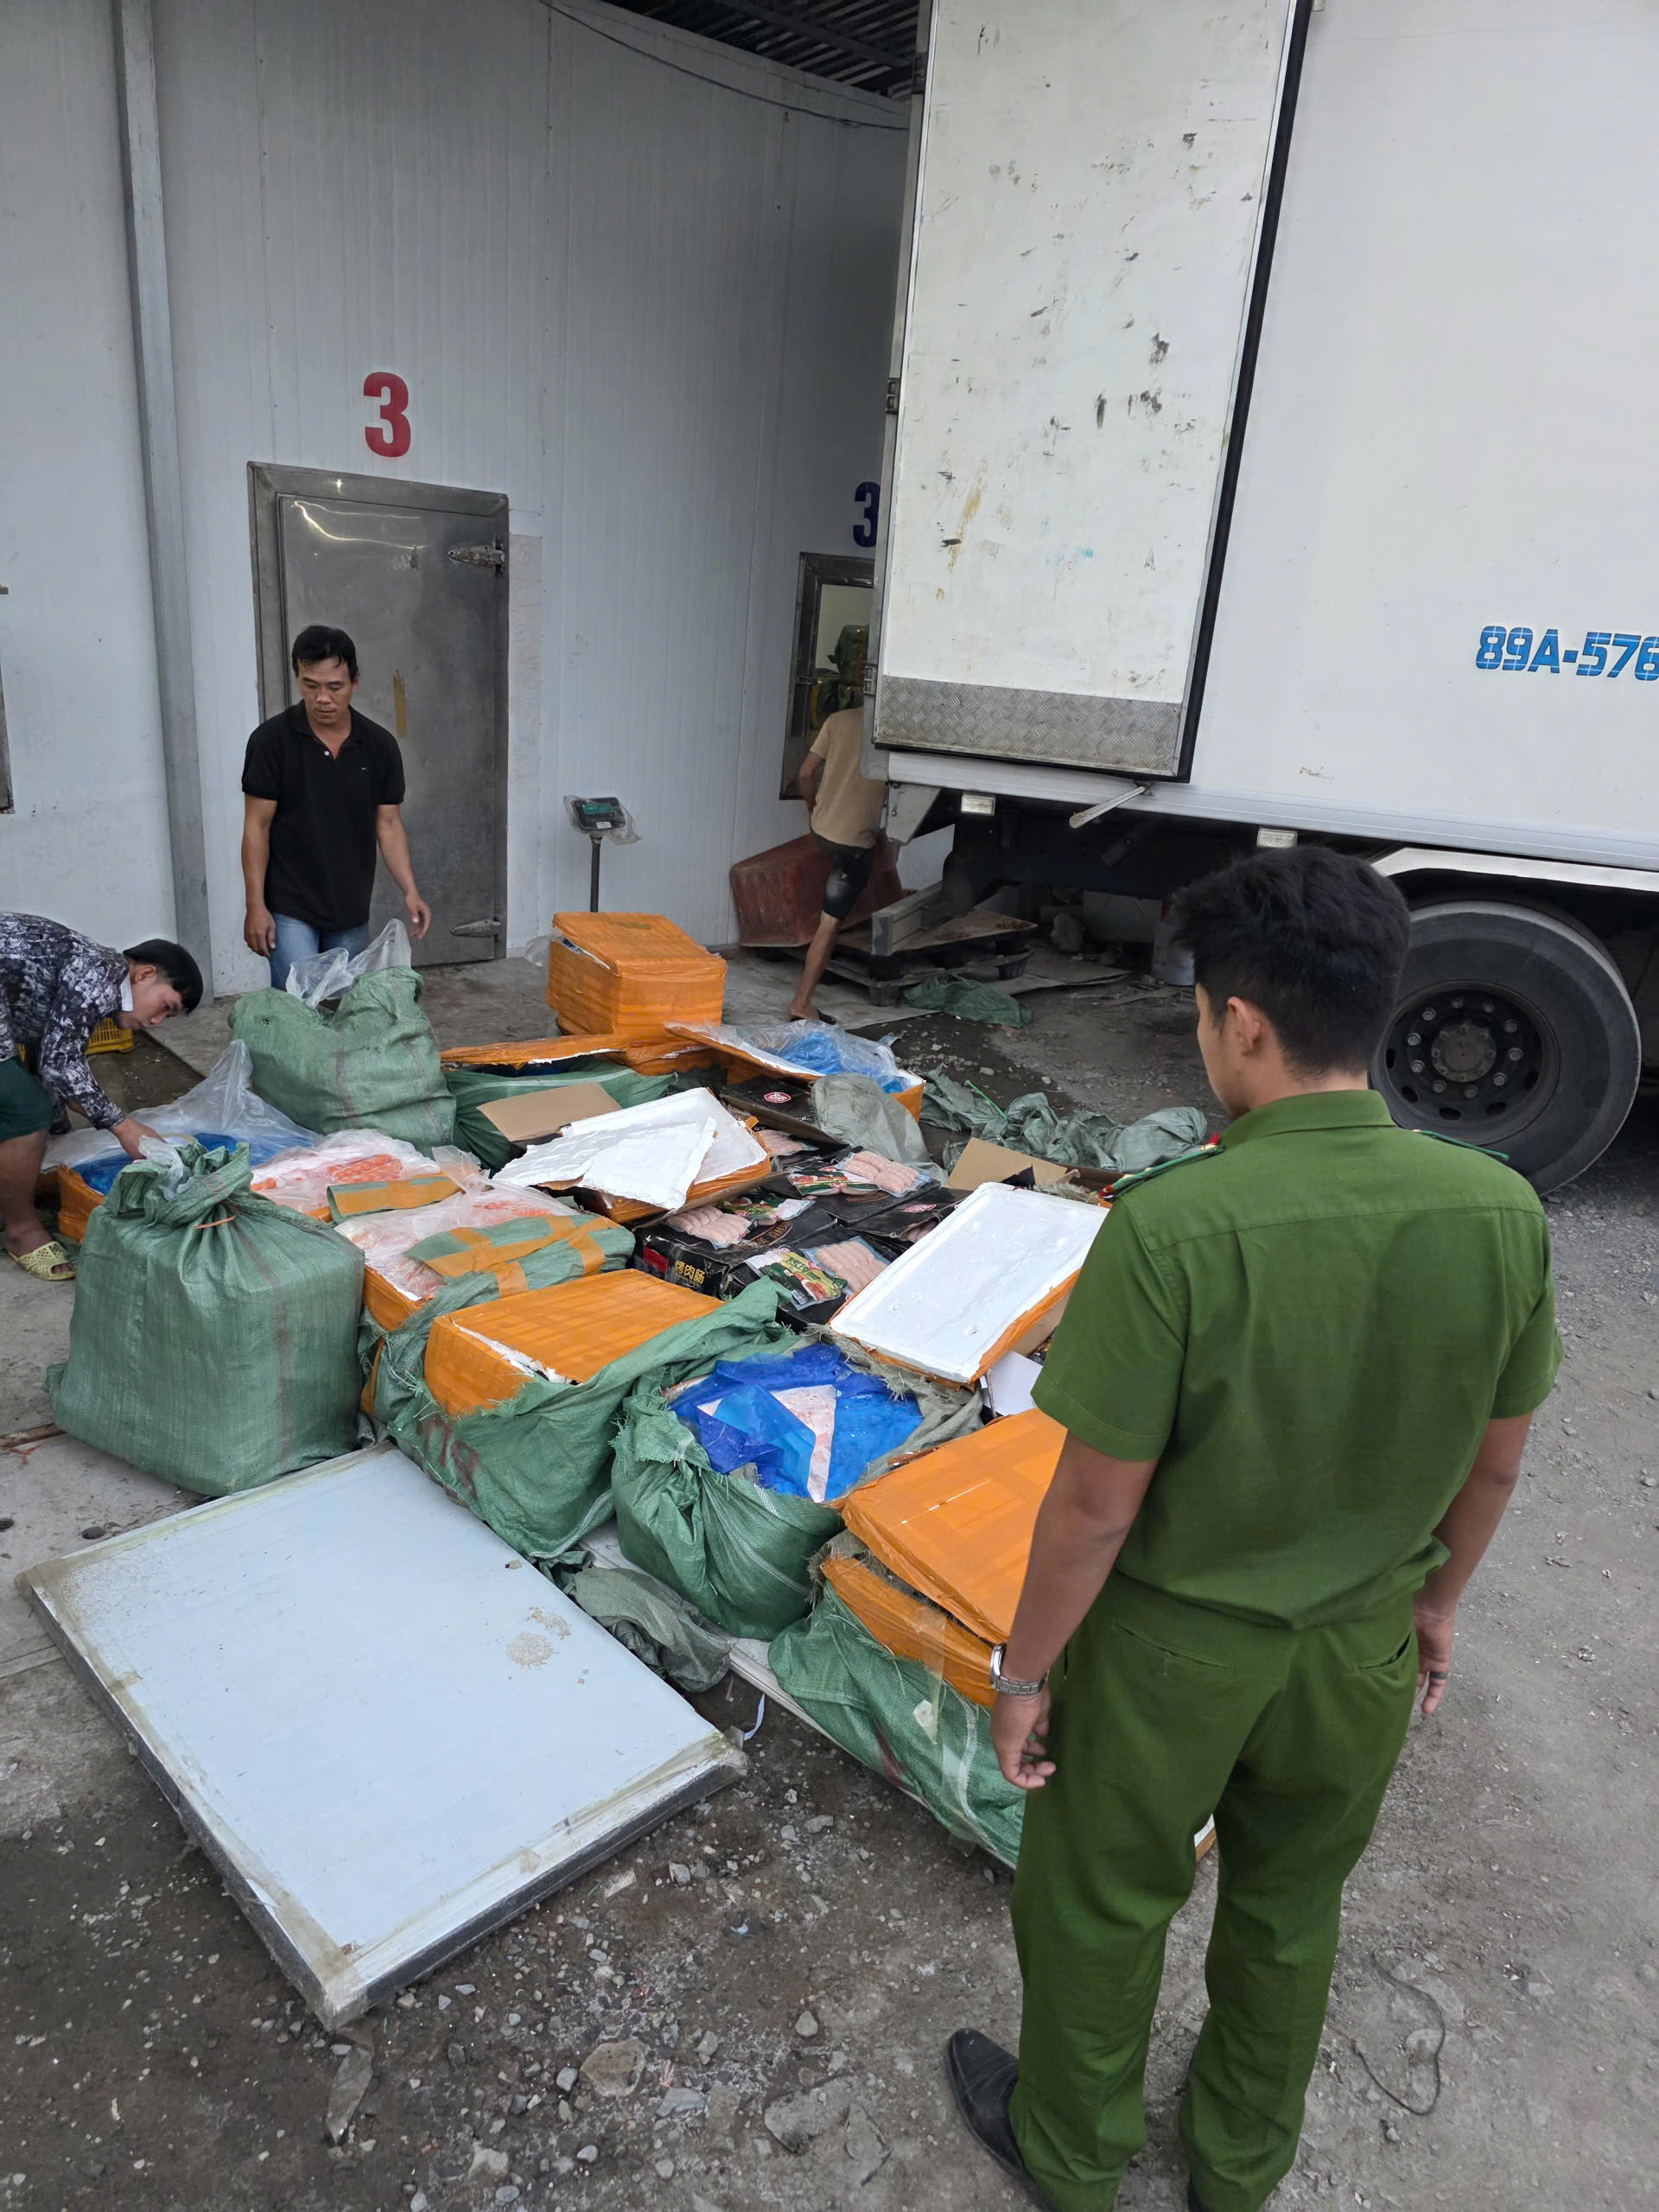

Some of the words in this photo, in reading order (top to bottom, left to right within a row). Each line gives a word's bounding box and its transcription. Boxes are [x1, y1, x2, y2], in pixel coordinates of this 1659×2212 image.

[363, 372, 411, 458] 3
[853, 481, 880, 548] 3
[1475, 625, 1659, 682] 89A-576
